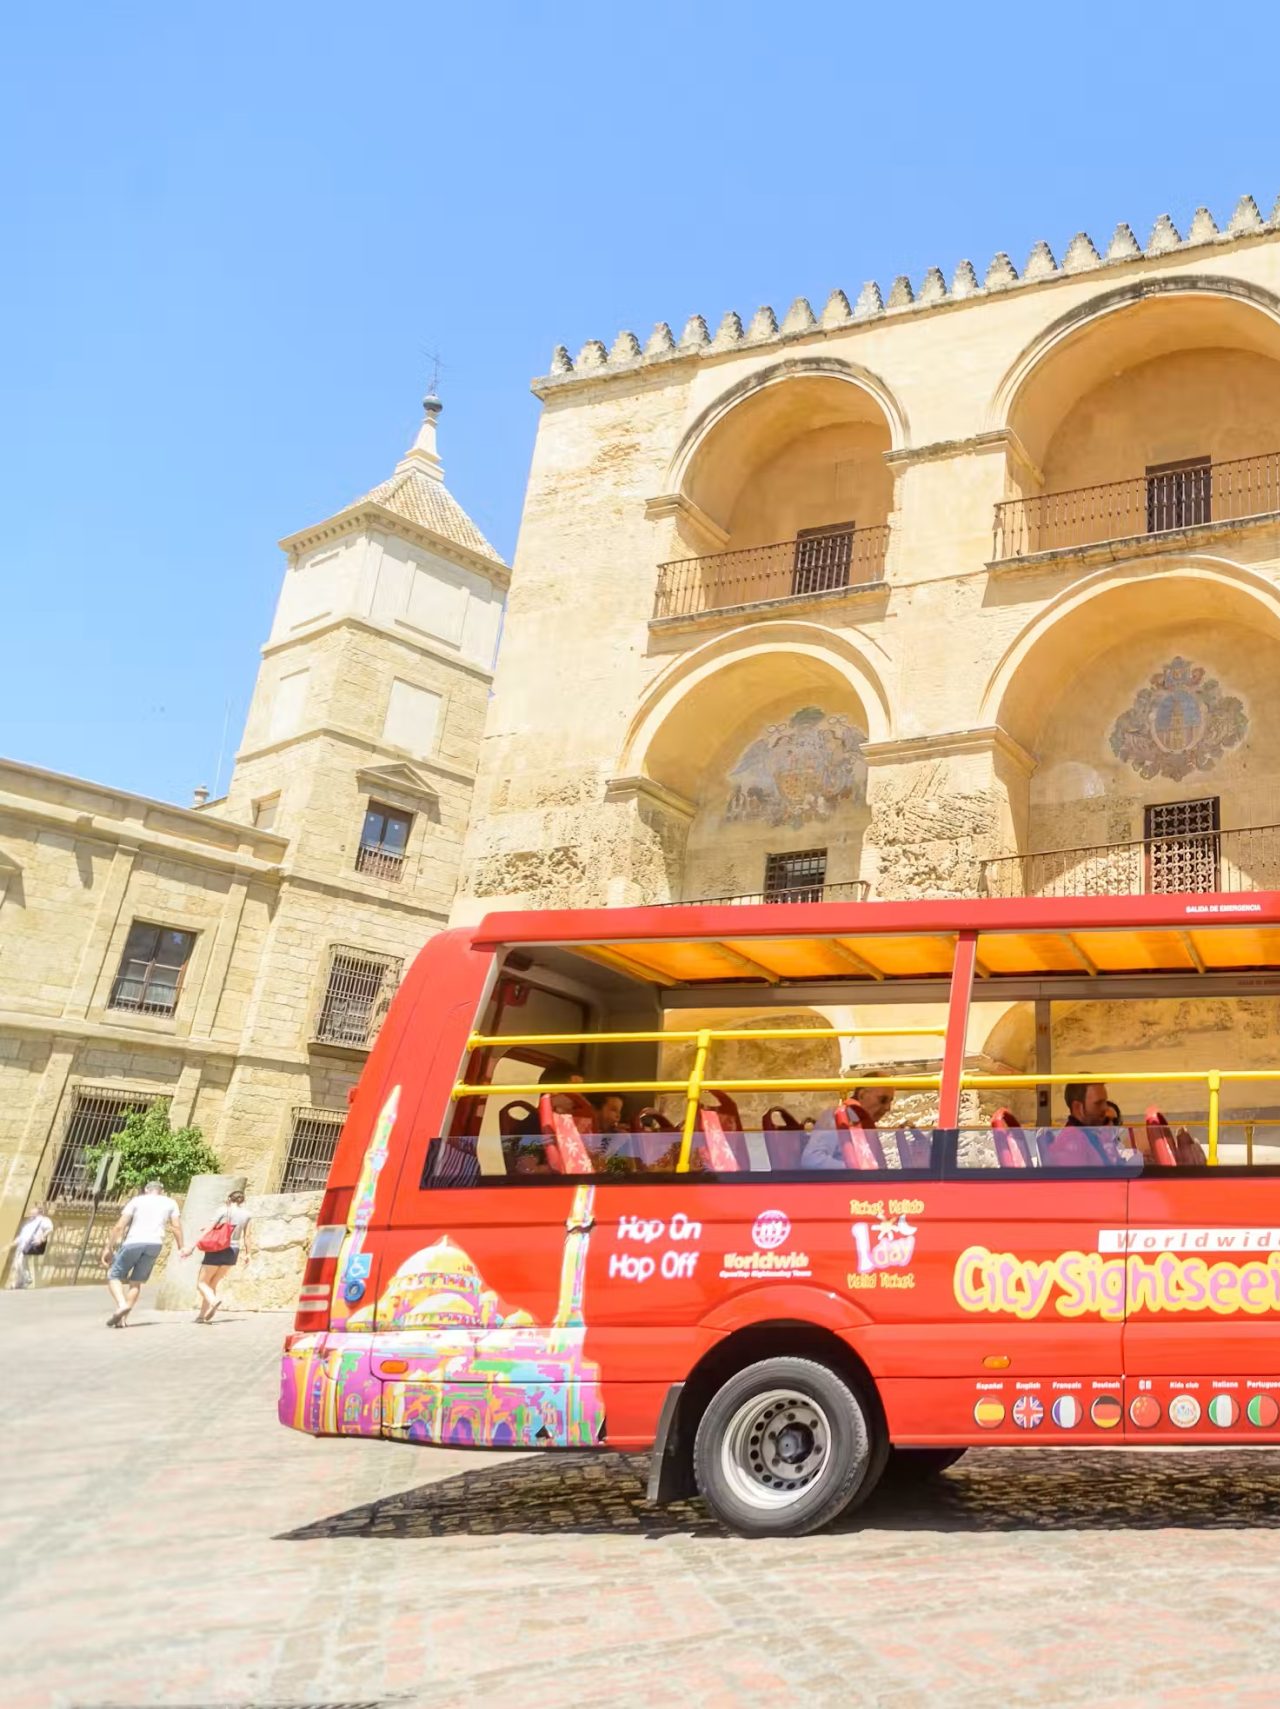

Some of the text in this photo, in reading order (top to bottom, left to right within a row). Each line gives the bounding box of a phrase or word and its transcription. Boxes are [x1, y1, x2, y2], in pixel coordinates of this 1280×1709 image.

[617, 1213, 702, 1243] Hop On
[608, 1250, 700, 1283] Hop Off
[872, 1238, 915, 1268] day
[1016, 1382, 1041, 1390] English
[1092, 1381, 1120, 1389] Deutsch
